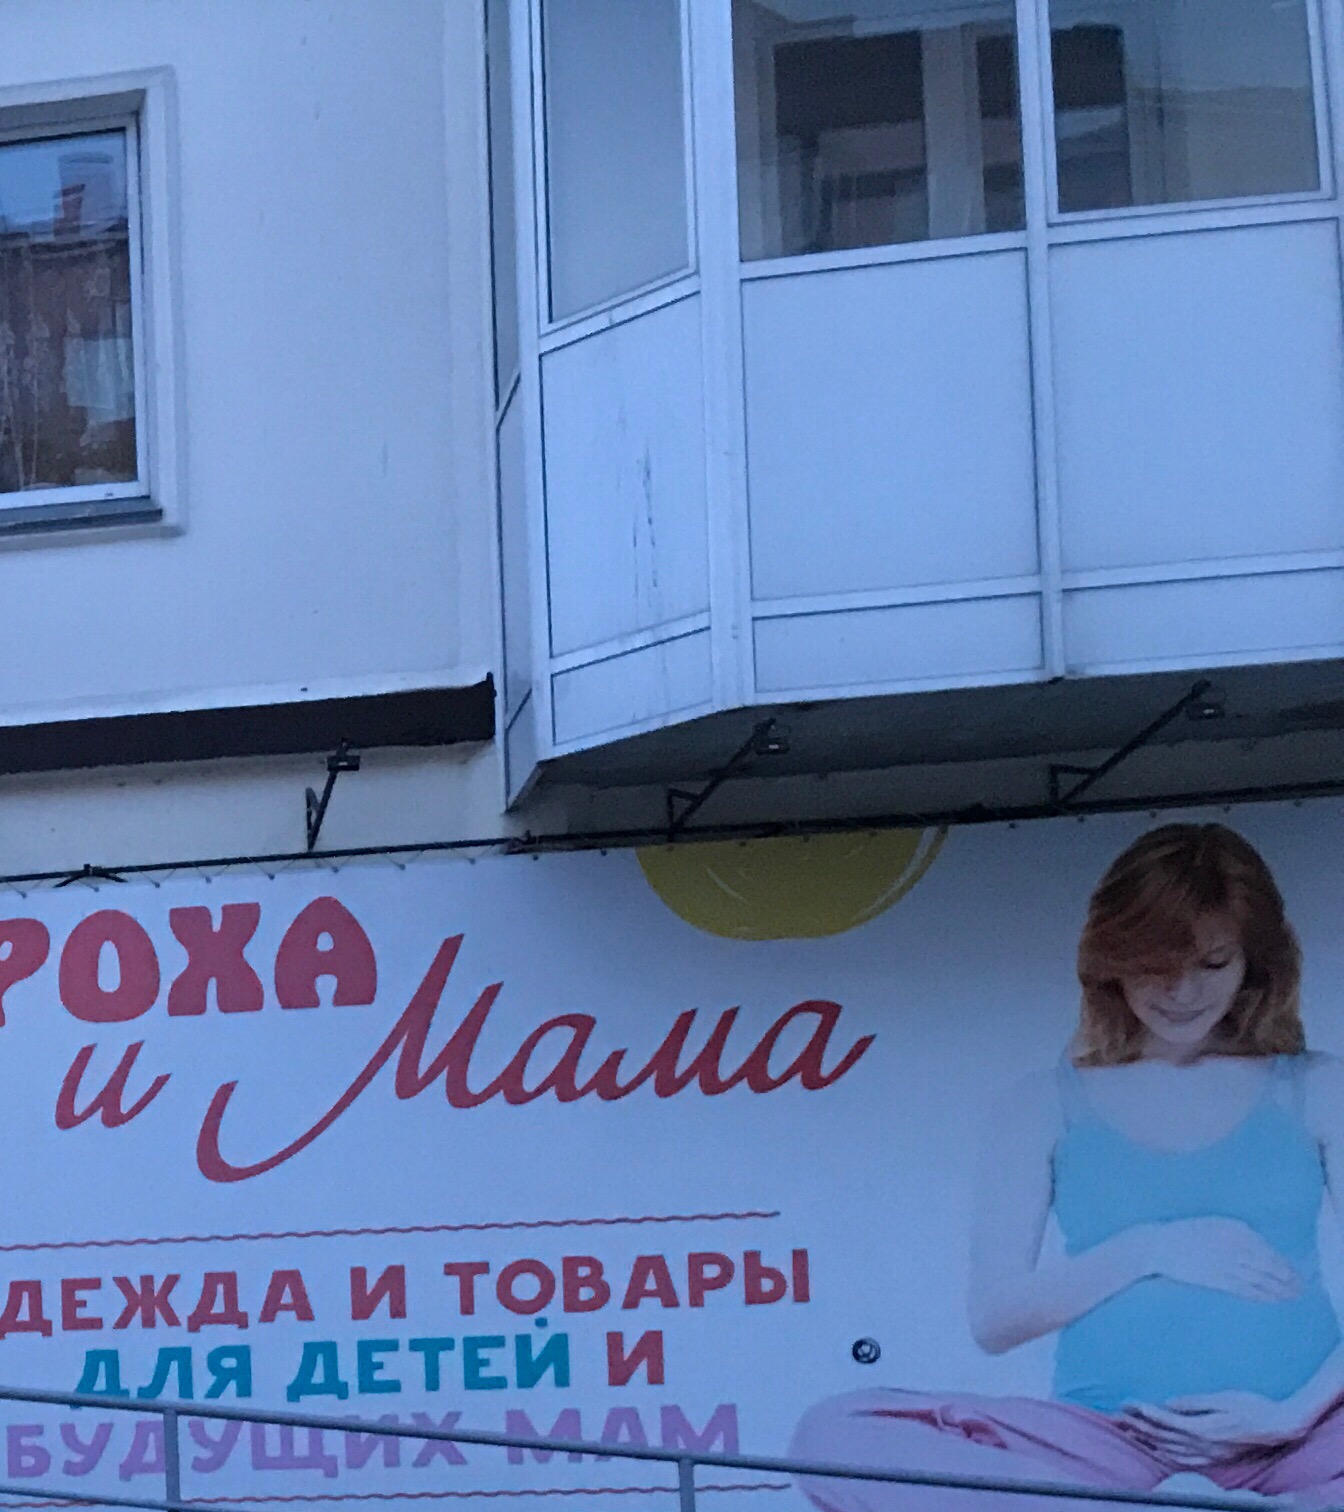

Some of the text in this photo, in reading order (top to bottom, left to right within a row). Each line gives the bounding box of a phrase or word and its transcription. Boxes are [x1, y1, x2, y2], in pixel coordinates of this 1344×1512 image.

[55, 932, 876, 1183] и Мама
[350, 1265, 407, 1320] И
[444, 1249, 810, 1316] ТОВАРЫ
[71, 1317, 665, 1410] ДЛЯ ДЕТЕЙ И
[5, 1404, 741, 1482] БУДУЩИХ МАМ
